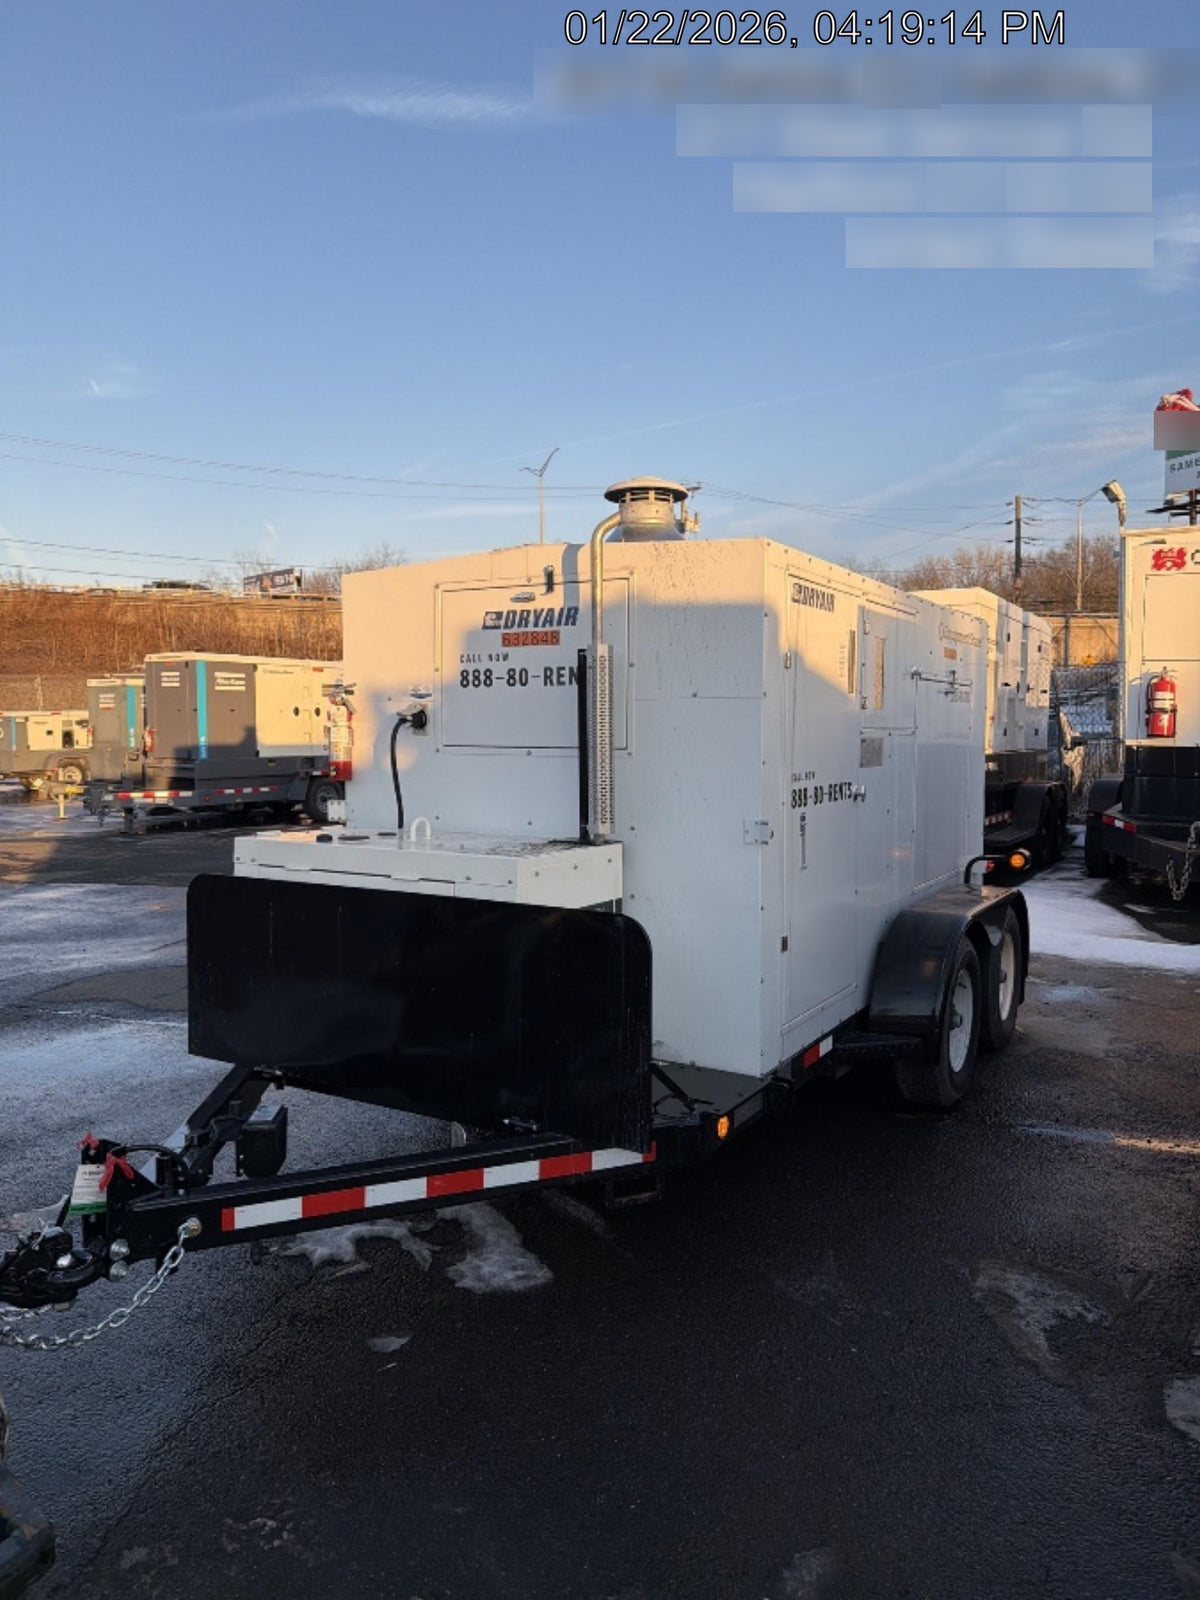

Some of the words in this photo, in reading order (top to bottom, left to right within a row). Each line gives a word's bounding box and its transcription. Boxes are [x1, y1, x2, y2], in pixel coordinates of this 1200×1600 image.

[503, 606, 580, 628] DRYAIR
[502, 630, 560, 646] 632848
[460, 653, 482, 664] CALL
[488, 652, 509, 663] NOW
[460, 666, 578, 688] 888-80-REN
